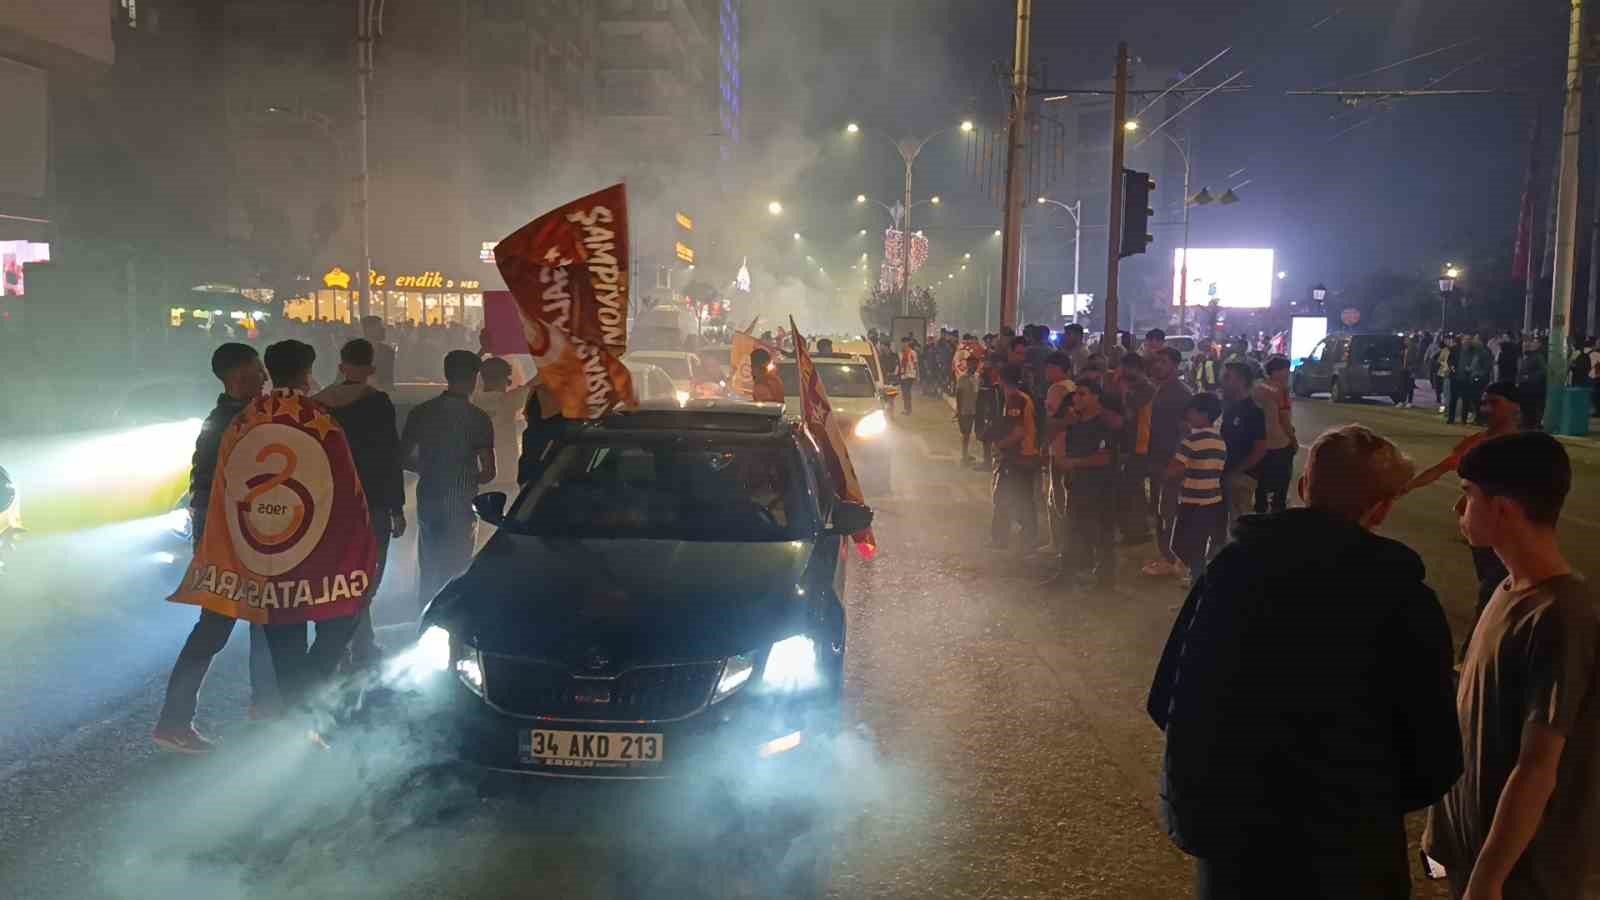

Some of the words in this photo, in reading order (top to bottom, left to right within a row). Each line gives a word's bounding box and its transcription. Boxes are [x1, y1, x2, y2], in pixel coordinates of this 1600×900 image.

[533, 732, 559, 755] 34
[569, 734, 610, 758] AKD
[620, 736, 657, 759] 213
